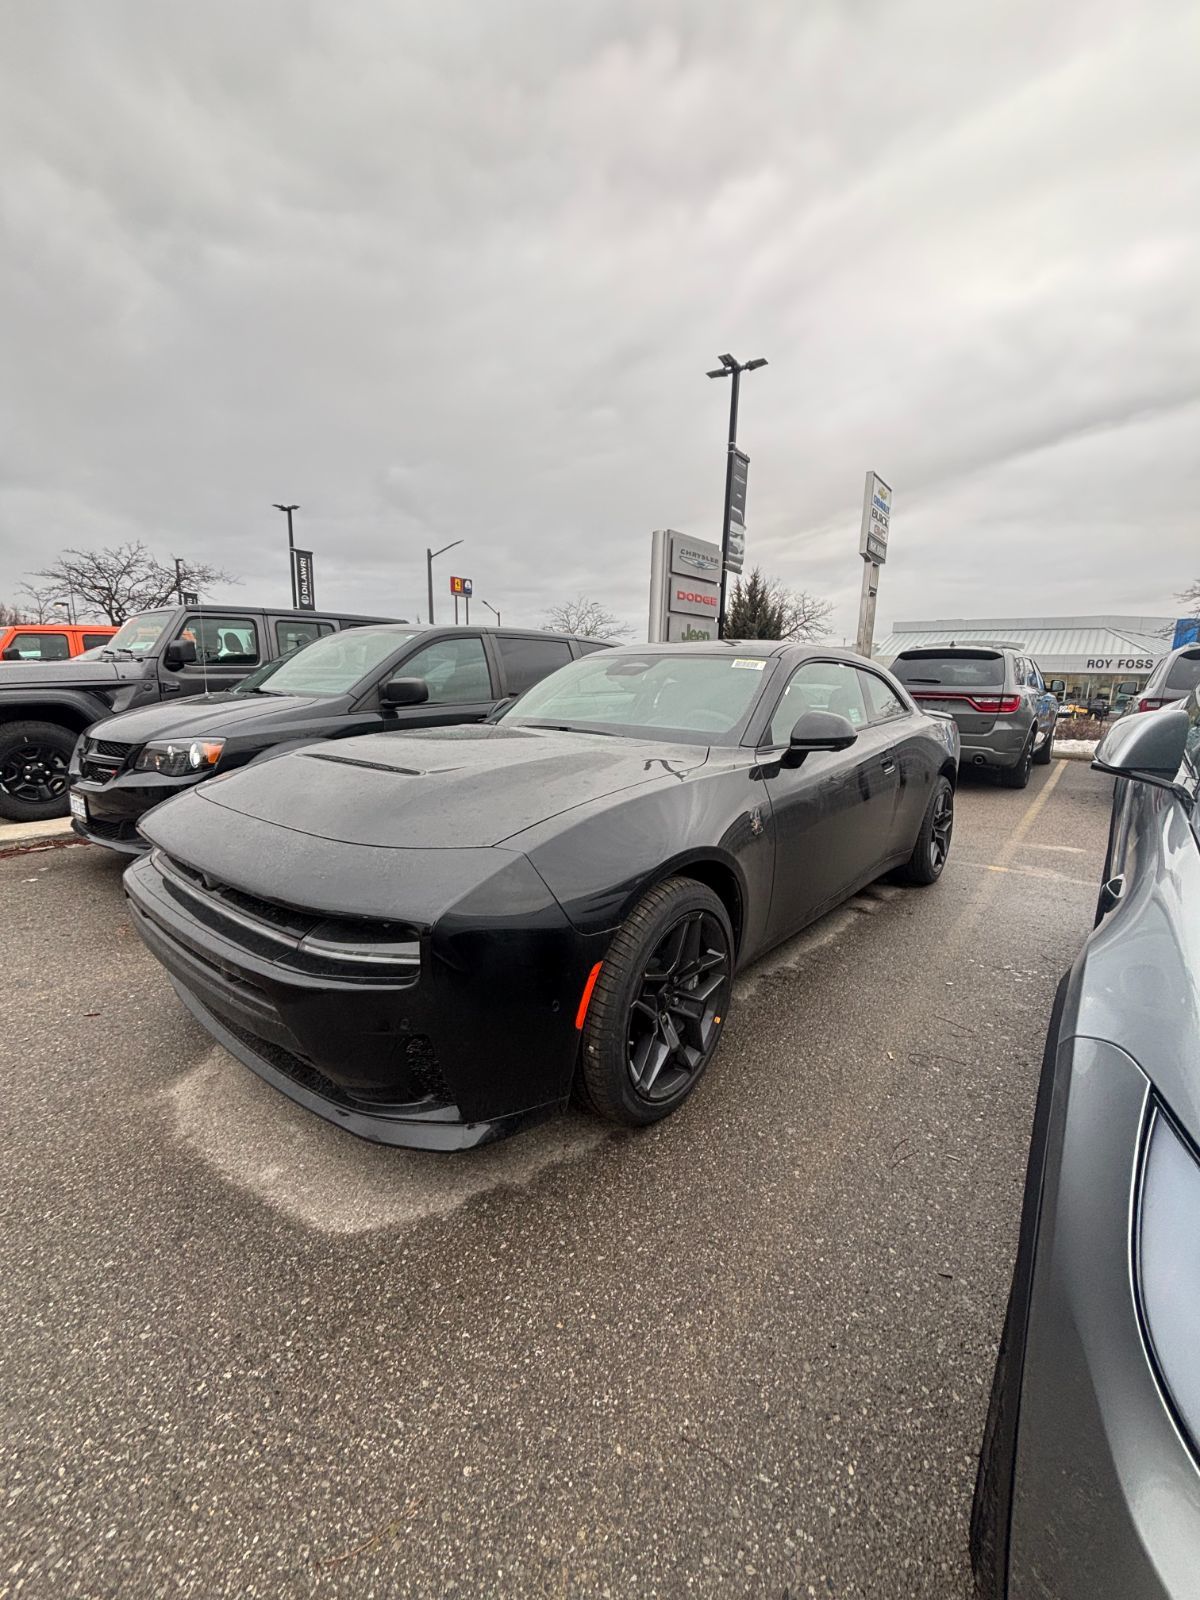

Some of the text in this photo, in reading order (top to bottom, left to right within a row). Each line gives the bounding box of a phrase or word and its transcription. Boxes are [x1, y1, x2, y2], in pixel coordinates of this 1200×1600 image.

[871, 508, 888, 528] BUICK
[680, 548, 719, 563] CHRYSLER
[300, 557, 308, 594] DILAWRI
[676, 591, 717, 606] DODGE
[1087, 659, 1154, 669] ROY FOSS
